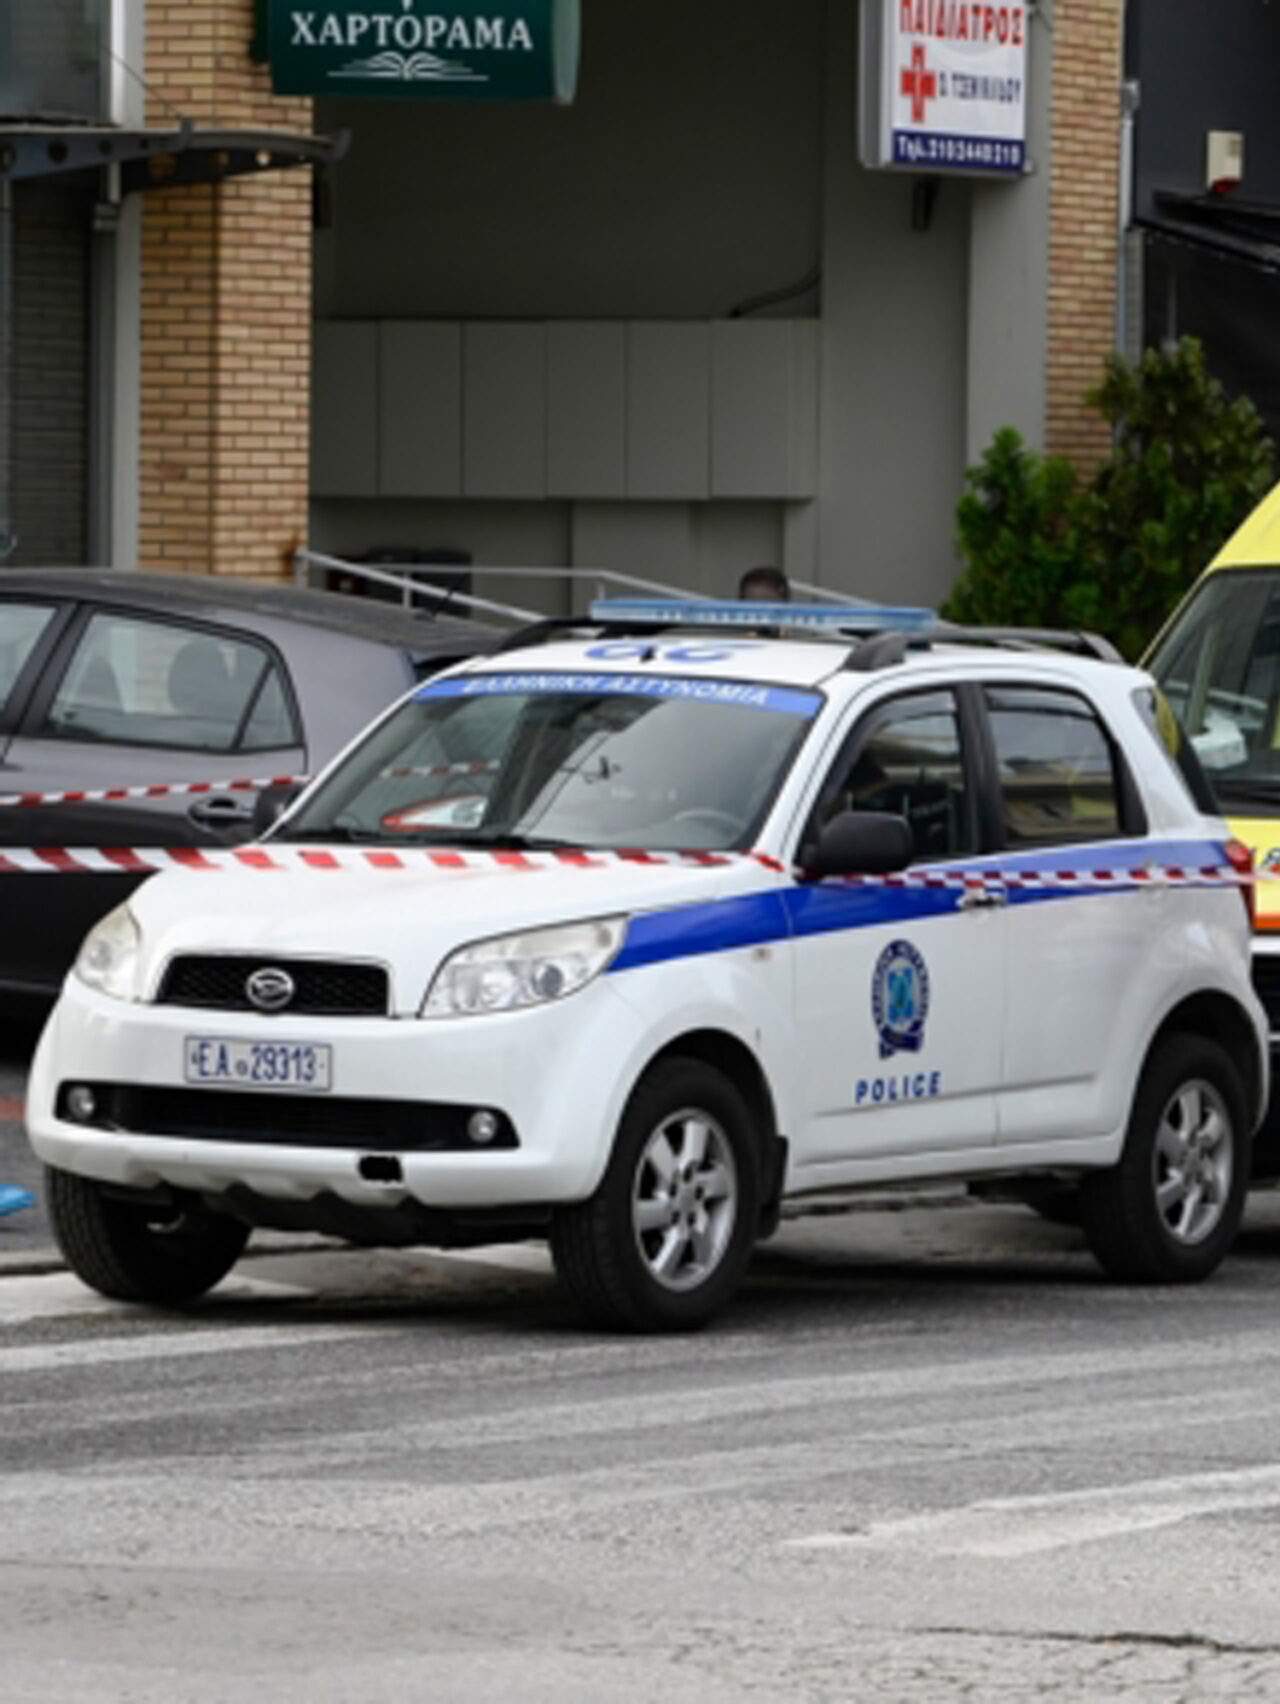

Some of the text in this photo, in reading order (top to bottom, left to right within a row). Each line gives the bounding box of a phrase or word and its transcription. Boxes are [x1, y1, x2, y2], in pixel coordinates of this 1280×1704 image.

[290, 12, 534, 50] ΧΑΡΤΟΡΑΜΑ
[899, 0, 1025, 46] ΠΑΙΔΙΑΤΡΟΣ
[854, 1070, 941, 1105] POLICE
